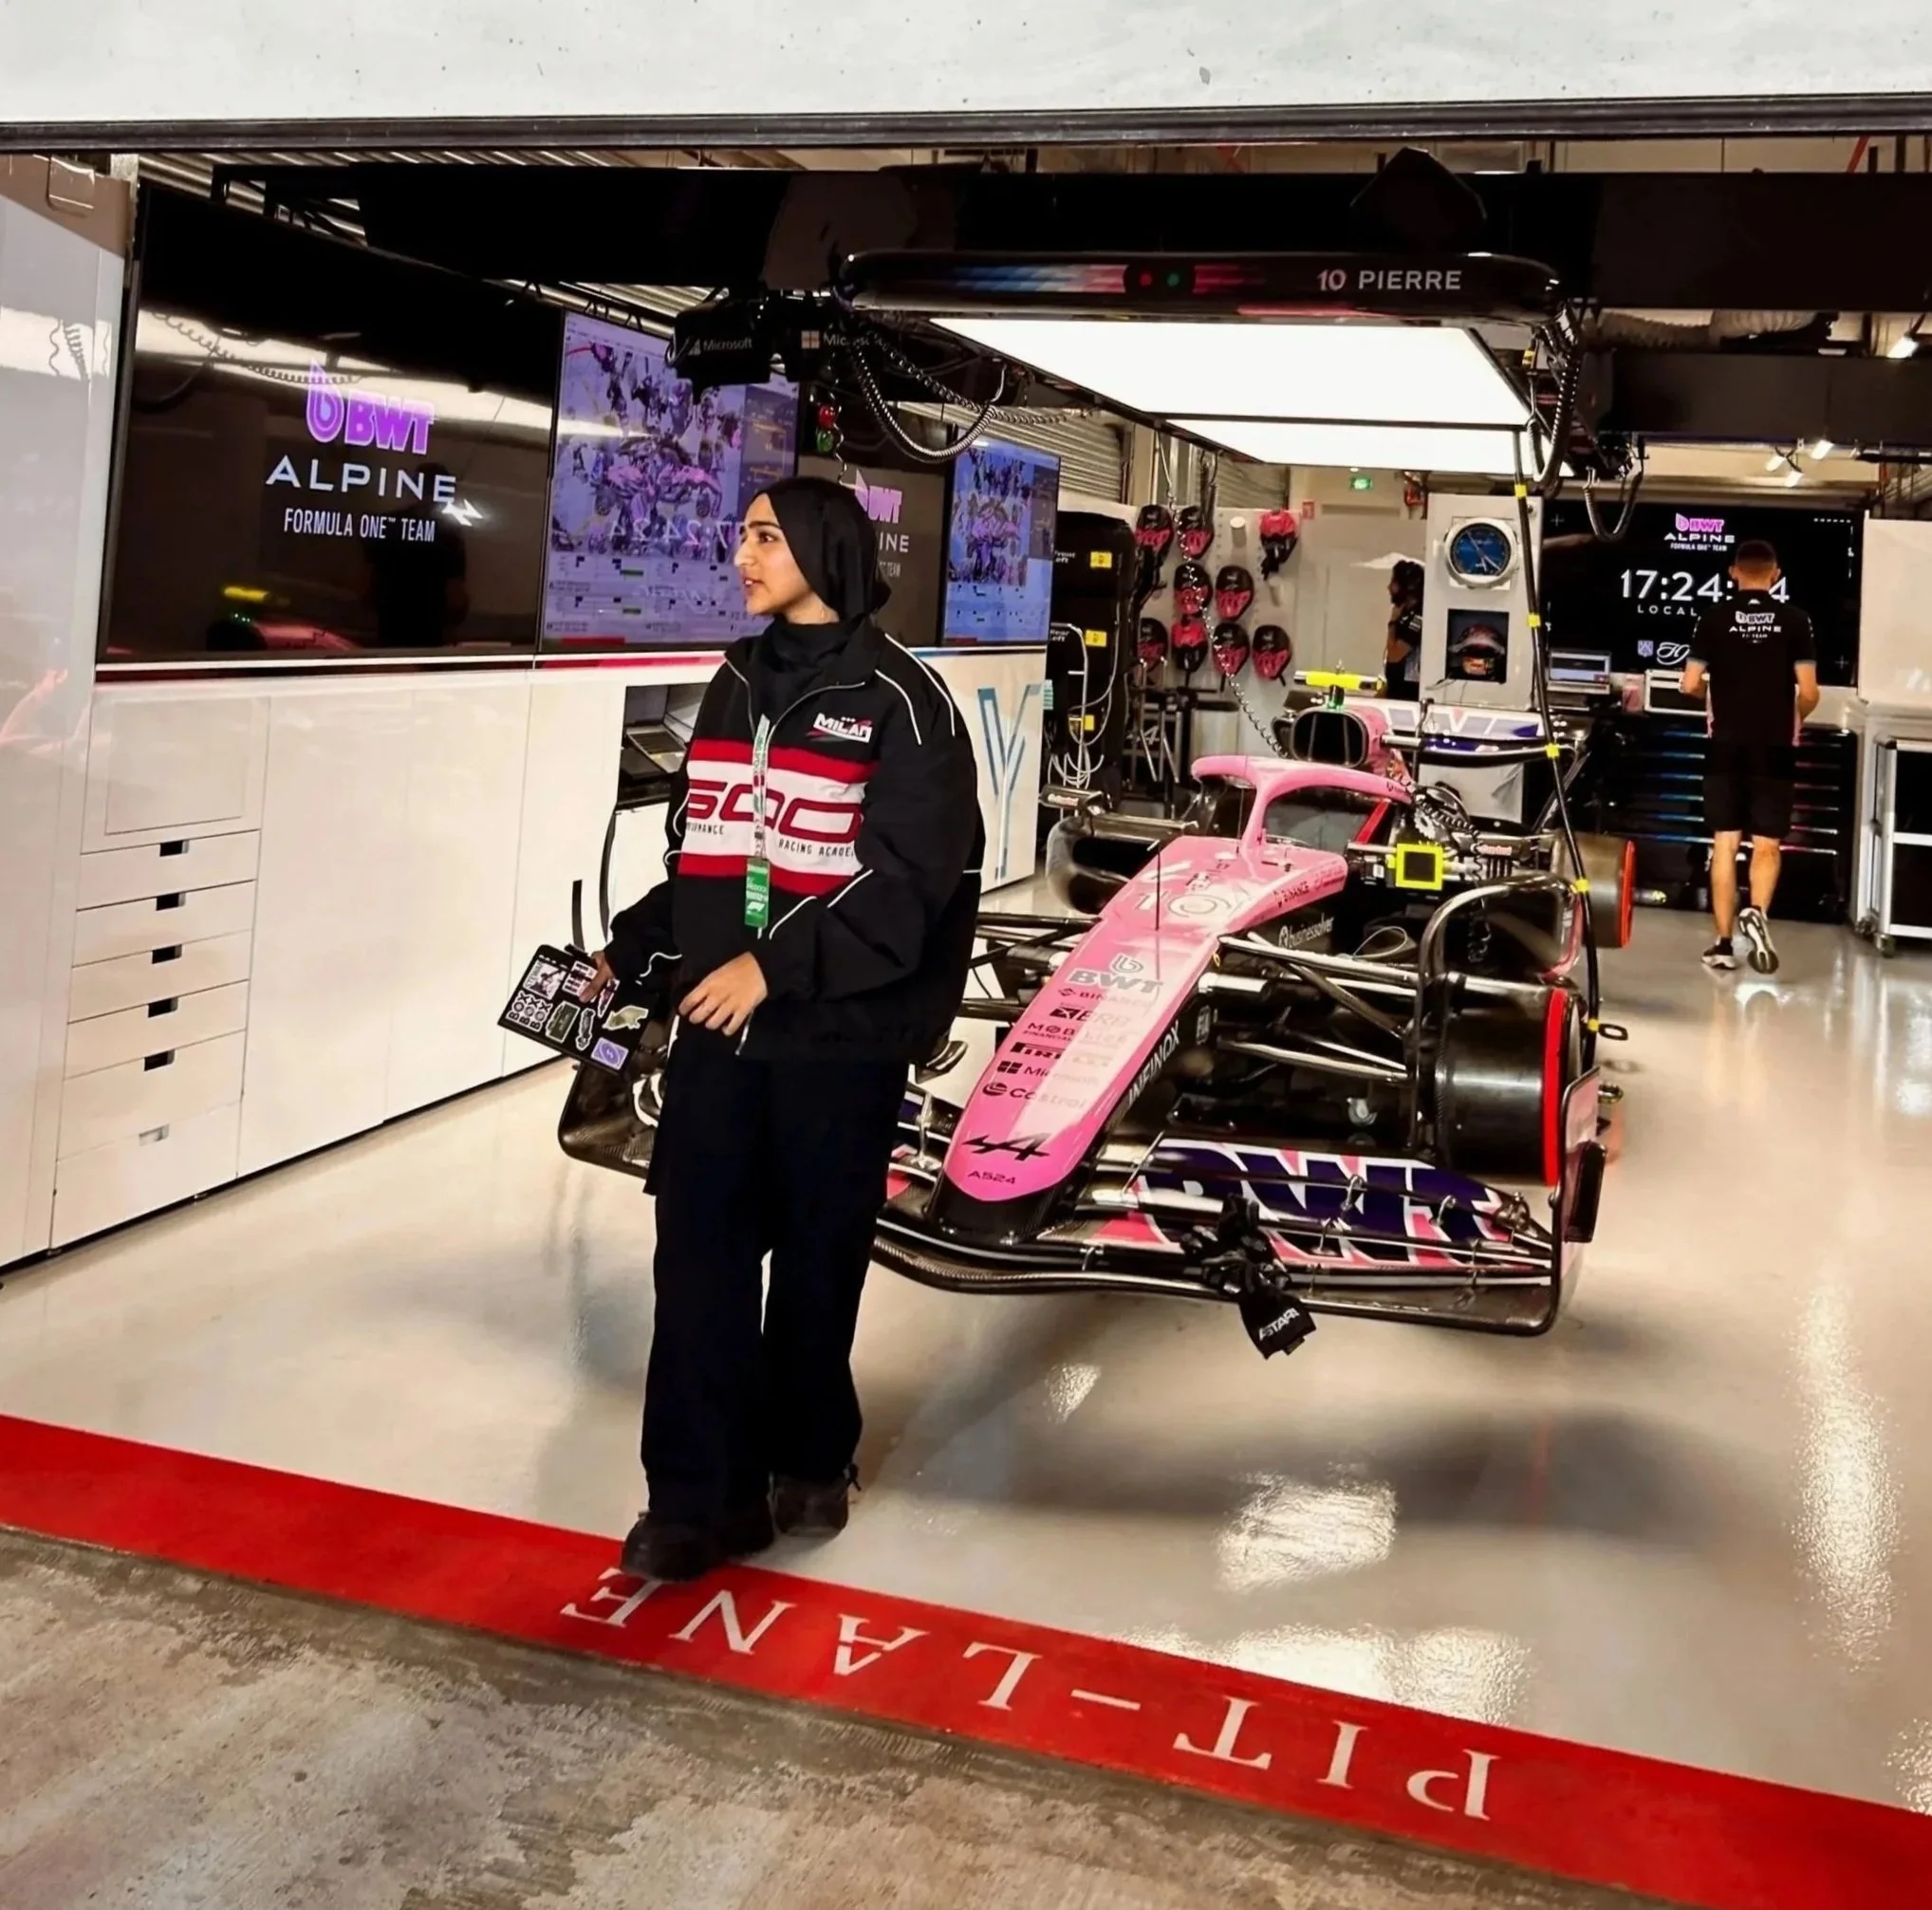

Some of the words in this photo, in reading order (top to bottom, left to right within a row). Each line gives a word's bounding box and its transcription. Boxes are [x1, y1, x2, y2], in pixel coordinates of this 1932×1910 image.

[1316, 269, 1347, 291] 10
[1358, 269, 1462, 290] PIERRE
[702, 337, 753, 351] Microsoft
[344, 389, 436, 454] BWT
[265, 455, 456, 503] ALPINE
[284, 508, 354, 537] FORMULA
[401, 517, 437, 542] TEAM
[1689, 517, 1725, 533] BWT
[879, 531, 910, 553] INE
[1663, 531, 1736, 544] ALPINE
[1620, 568, 1791, 604] 17:24:4
[1637, 604, 1698, 617] LOCAL
[813, 713, 873, 743] MILAN
[778, 839, 813, 855] RACING
[818, 846, 854, 858] ACADE
[1068, 967, 1163, 994] BWT
[967, 1169, 1016, 1185] A524
